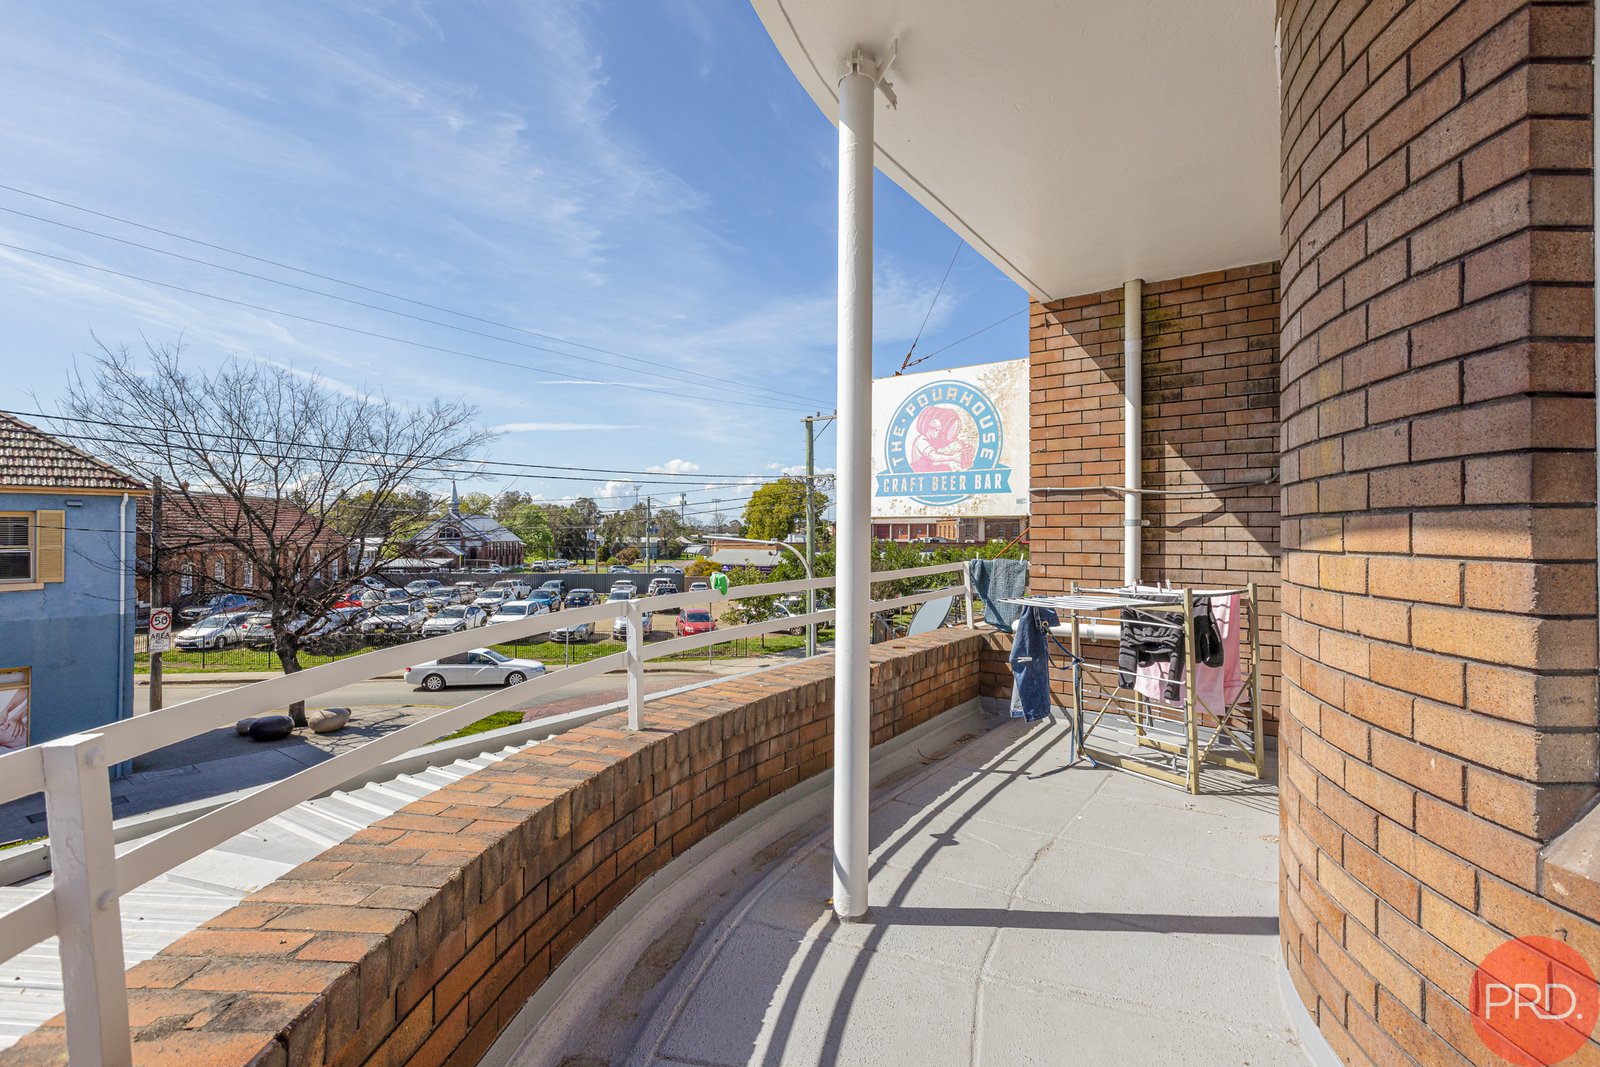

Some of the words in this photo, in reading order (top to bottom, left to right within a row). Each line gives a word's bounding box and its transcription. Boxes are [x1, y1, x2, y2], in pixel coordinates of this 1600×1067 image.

[891, 425, 905, 467] THE
[905, 387, 996, 460] POURHOUSE
[883, 476, 925, 493] CRAFT
[932, 475, 967, 492] BEER
[975, 473, 1003, 490] BAR
[154, 616, 168, 626] 50
[150, 632, 170, 640] AREA
